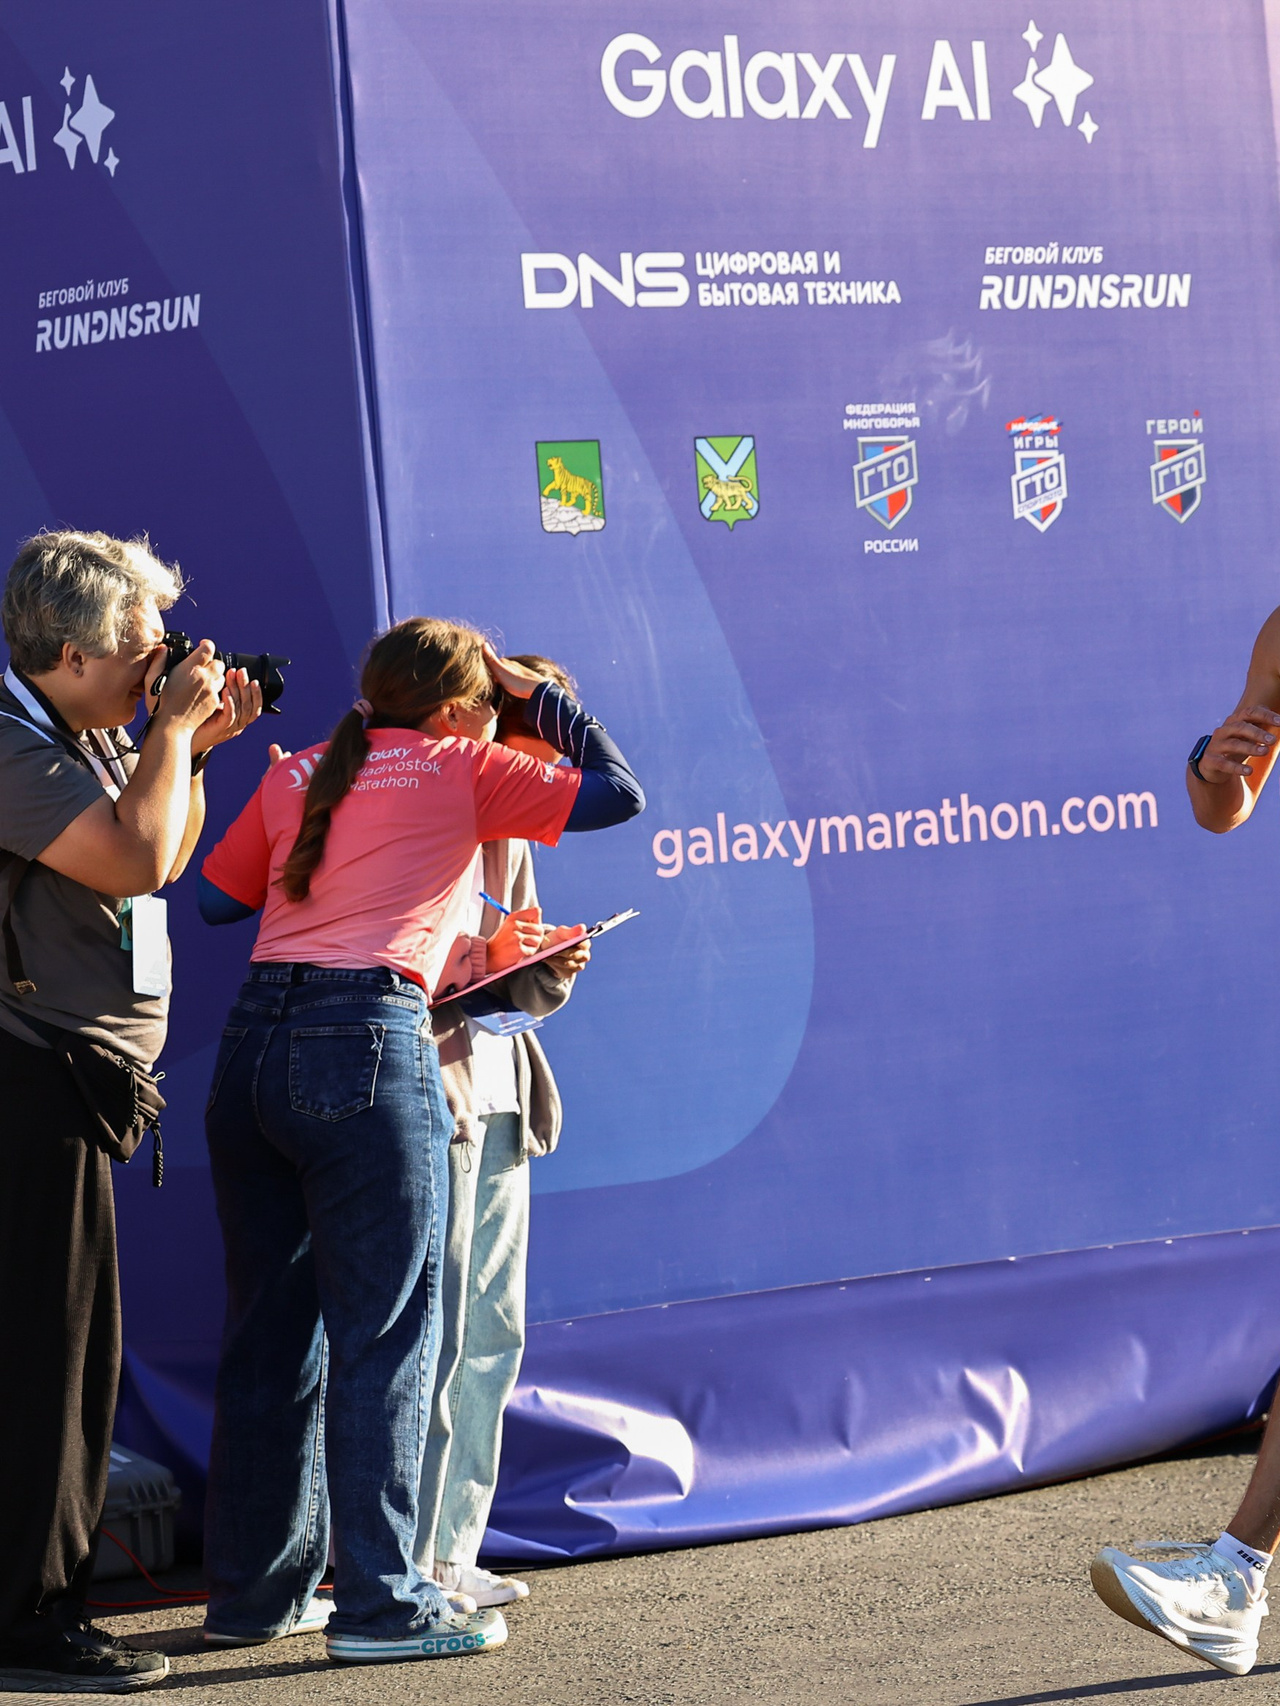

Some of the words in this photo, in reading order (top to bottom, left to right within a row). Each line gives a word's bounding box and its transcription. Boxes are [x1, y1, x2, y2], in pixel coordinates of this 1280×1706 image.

[600, 32, 897, 148] Galaxy
[921, 39, 991, 121] AI
[696, 251, 818, 279] ЦИФРОВАЯ
[823, 251, 841, 275] И
[984, 242, 1059, 265] БЕГОВОЙ
[1061, 246, 1104, 265] КЛУБ
[38, 279, 95, 309] БЕГОВОЙ
[97, 277, 130, 299] КЛУБ
[520, 252, 690, 309] DNS
[697, 282, 799, 308] БЫТОВАЯ
[802, 281, 901, 306] ТЕХНИКА
[979, 273, 1192, 310] RUNDNSRUN
[36, 293, 201, 353] RUNDNSRUN
[843, 416, 921, 430] МНОГОБОРЬЯ
[845, 402, 916, 416] ФЕДЕРАЦИЯ
[1013, 435, 1060, 449] ИГРЫ
[861, 454, 910, 498] ГТО
[1019, 466, 1060, 503] ГТО
[1157, 456, 1199, 494] ГТО
[864, 538, 919, 554] РОССИИ
[366, 747, 413, 762] alaxy
[651, 791, 1159, 878] galaxymarathon.com
[421, 1632, 486, 1654] crocs
